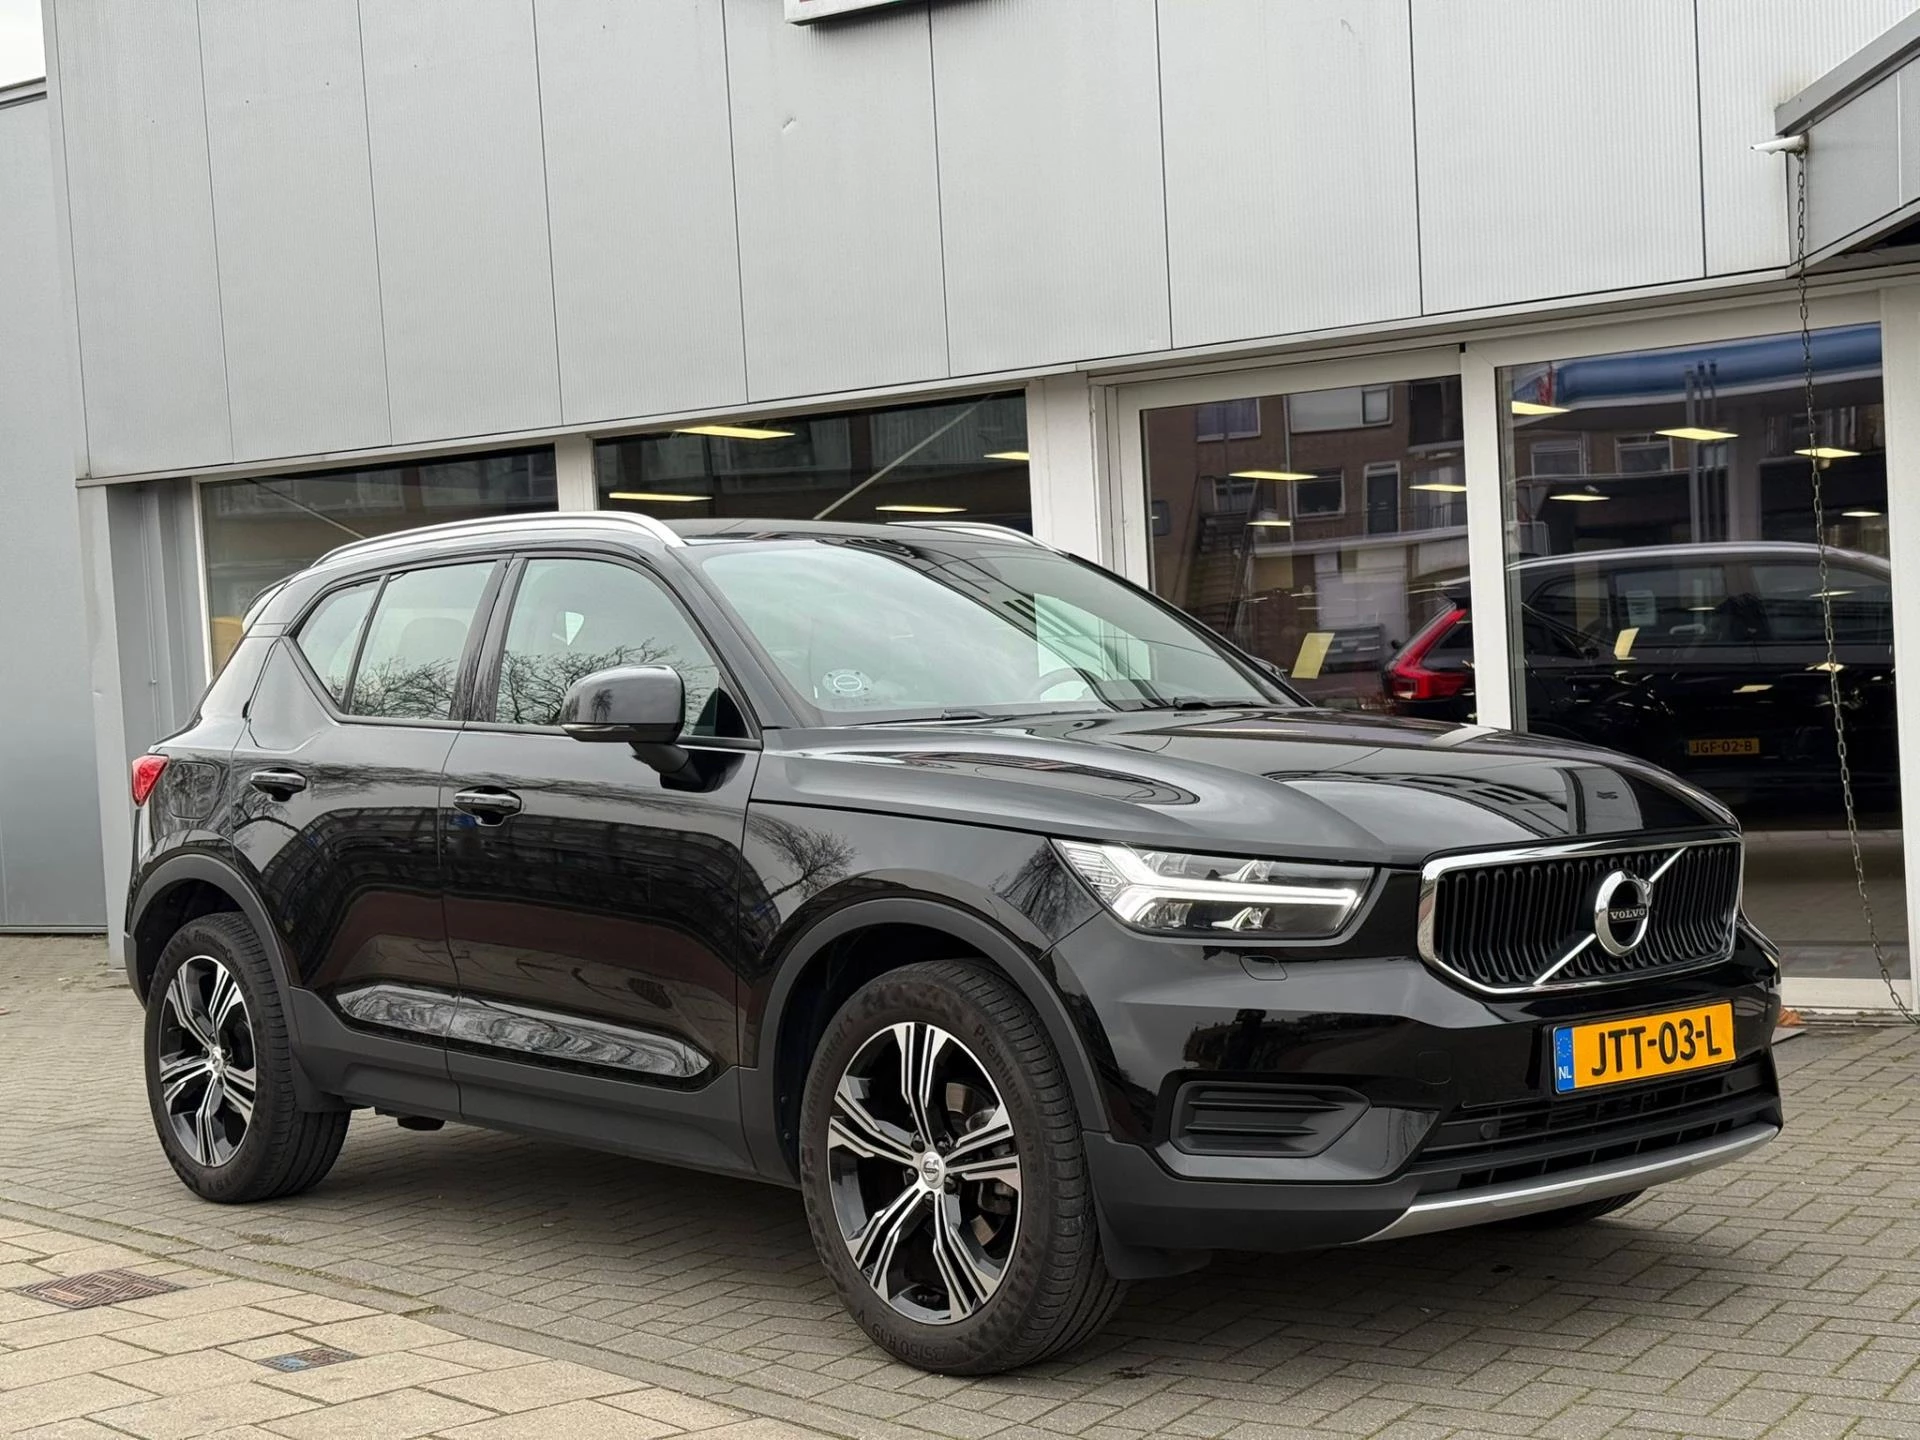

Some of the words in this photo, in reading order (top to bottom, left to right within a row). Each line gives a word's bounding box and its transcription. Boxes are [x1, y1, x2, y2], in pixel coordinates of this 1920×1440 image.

[1693, 740, 1752, 753] JGF-02-B
[1609, 908, 1645, 919] VOLVO
[1591, 1015, 1722, 1077] JTT-03-L
[1558, 1066, 1572, 1081] NL
